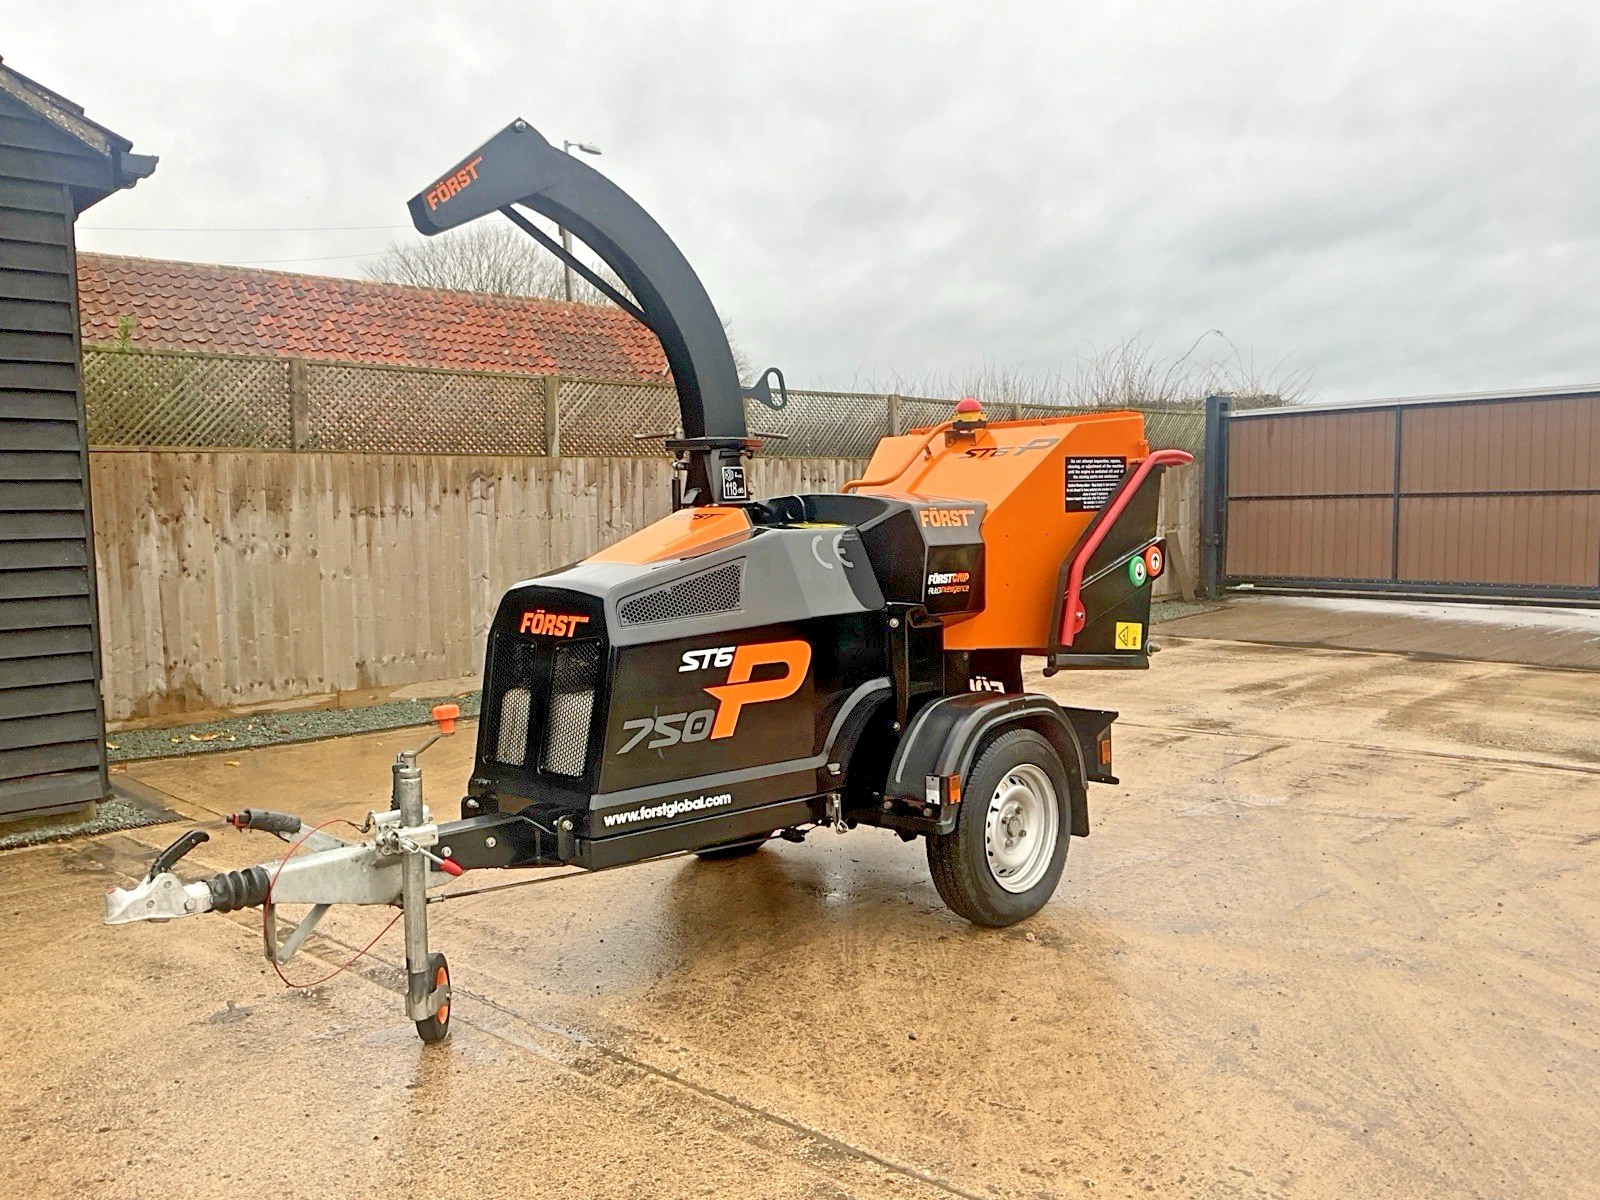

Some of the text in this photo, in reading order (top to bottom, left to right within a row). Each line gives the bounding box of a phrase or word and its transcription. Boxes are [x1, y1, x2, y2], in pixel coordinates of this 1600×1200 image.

[426, 157, 481, 211] FÖRST
[725, 482, 738, 496] 118
[919, 507, 971, 528] FÖRST
[520, 609, 586, 638] FÖRST
[615, 708, 715, 755] 750
[603, 793, 732, 827] www.forstglobal.com
